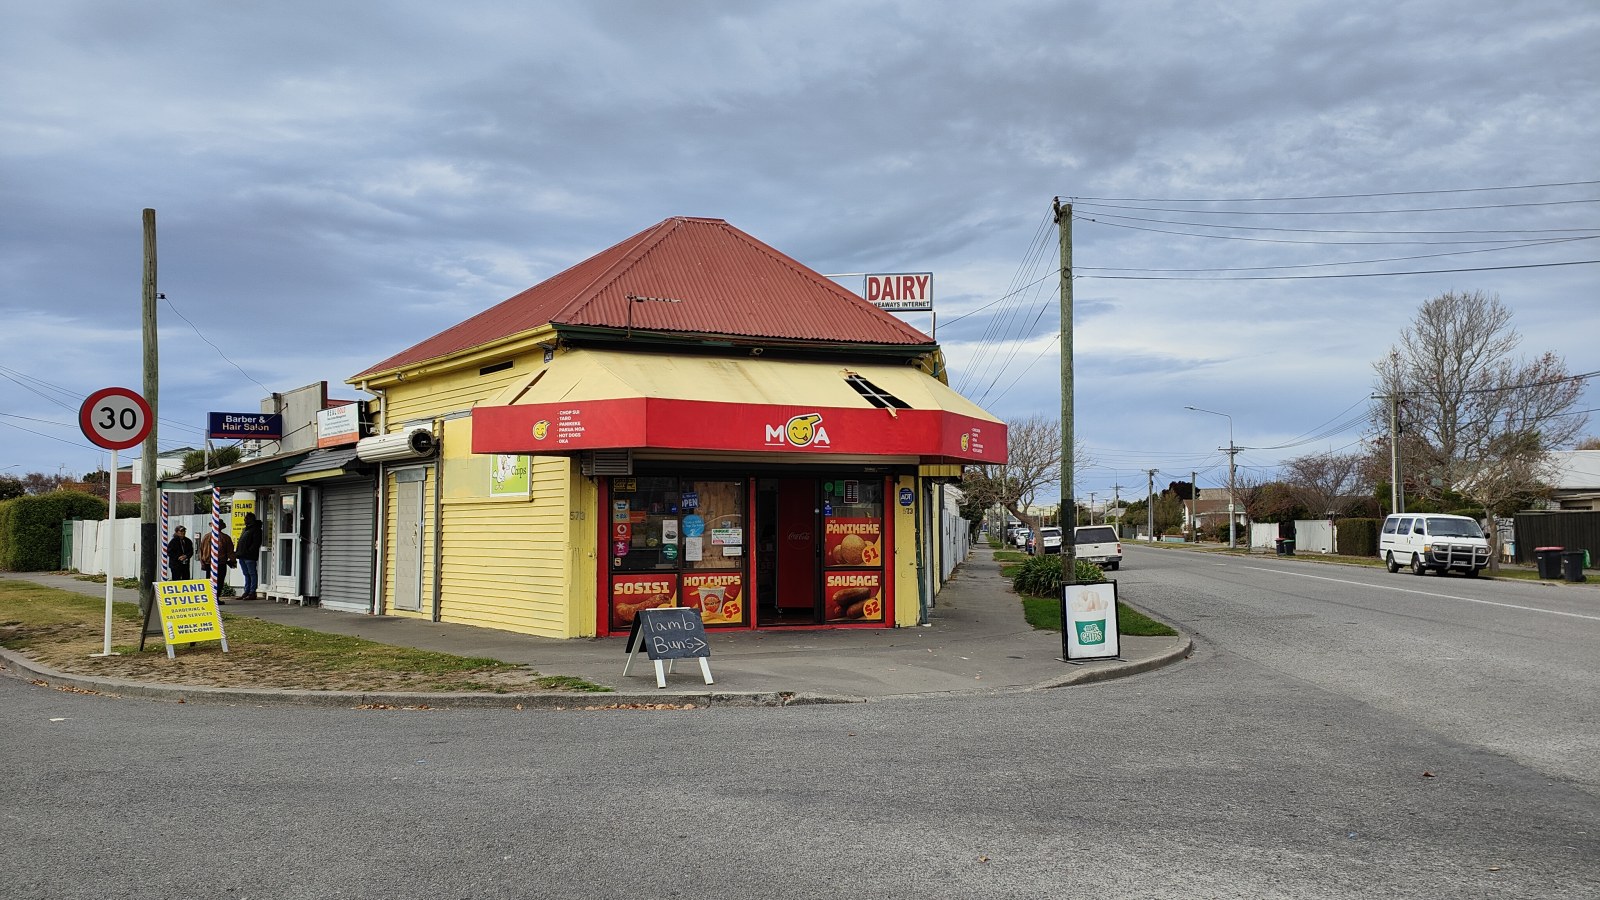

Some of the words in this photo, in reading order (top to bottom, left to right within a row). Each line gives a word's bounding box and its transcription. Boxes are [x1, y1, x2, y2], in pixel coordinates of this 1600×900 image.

[868, 276, 929, 300] DAIRY
[99, 407, 136, 430] 30
[225, 415, 256, 423] Barber
[243, 423, 269, 431] Salon
[826, 523, 880, 534] PANIKEKE
[863, 547, 879, 563] $1
[683, 576, 702, 587] HOT
[704, 575, 741, 586] CHIPS
[827, 575, 879, 587] SAUSAGE
[162, 583, 206, 594] ISLAND
[614, 581, 670, 595] SOSISI
[164, 594, 209, 606] STYLES
[723, 603, 740, 619] $3
[864, 600, 880, 616] $2
[178, 626, 215, 634] WELCOME
[653, 636, 694, 654] Buns
